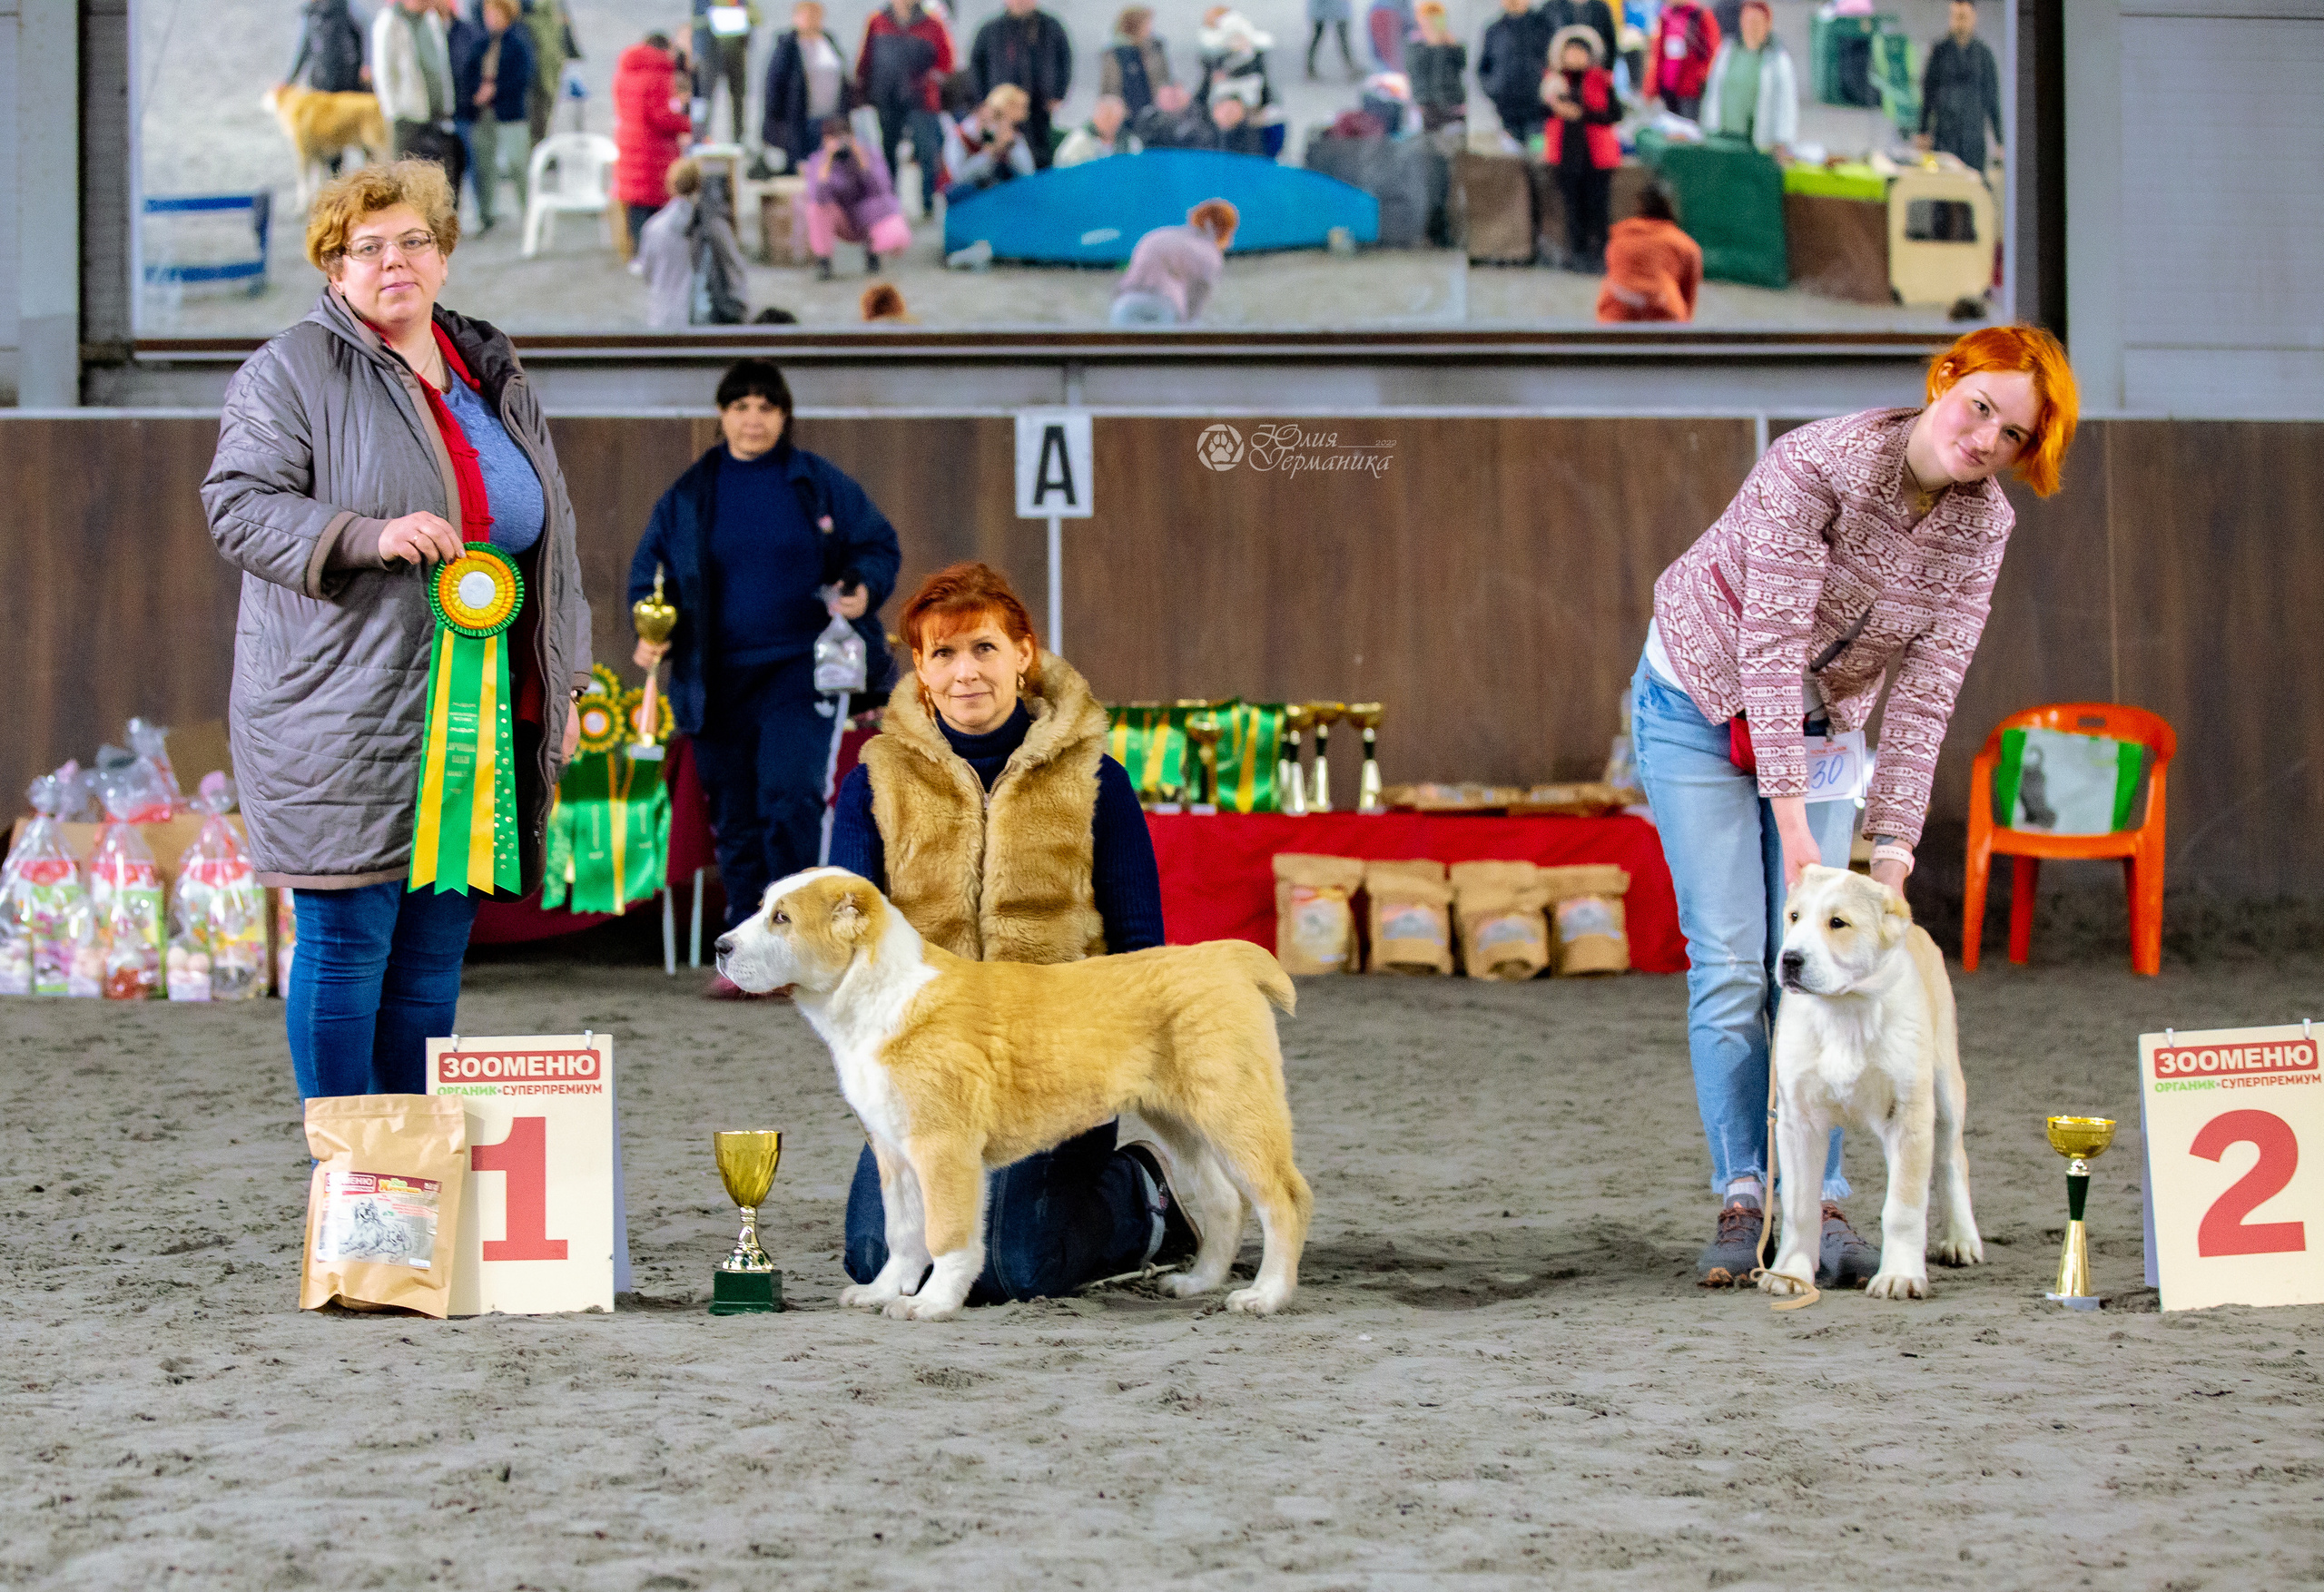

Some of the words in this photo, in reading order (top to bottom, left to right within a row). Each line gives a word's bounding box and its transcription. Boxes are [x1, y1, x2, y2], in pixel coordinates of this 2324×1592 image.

[1033, 425, 1078, 506] A
[1811, 754, 1844, 789] 30
[443, 1055, 596, 1078] ЗООМЕНЮ
[2159, 1045, 2314, 1074] ЗООМЕНЮ
[470, 1116, 568, 1262] 1
[2189, 1108, 2307, 1258] 2
